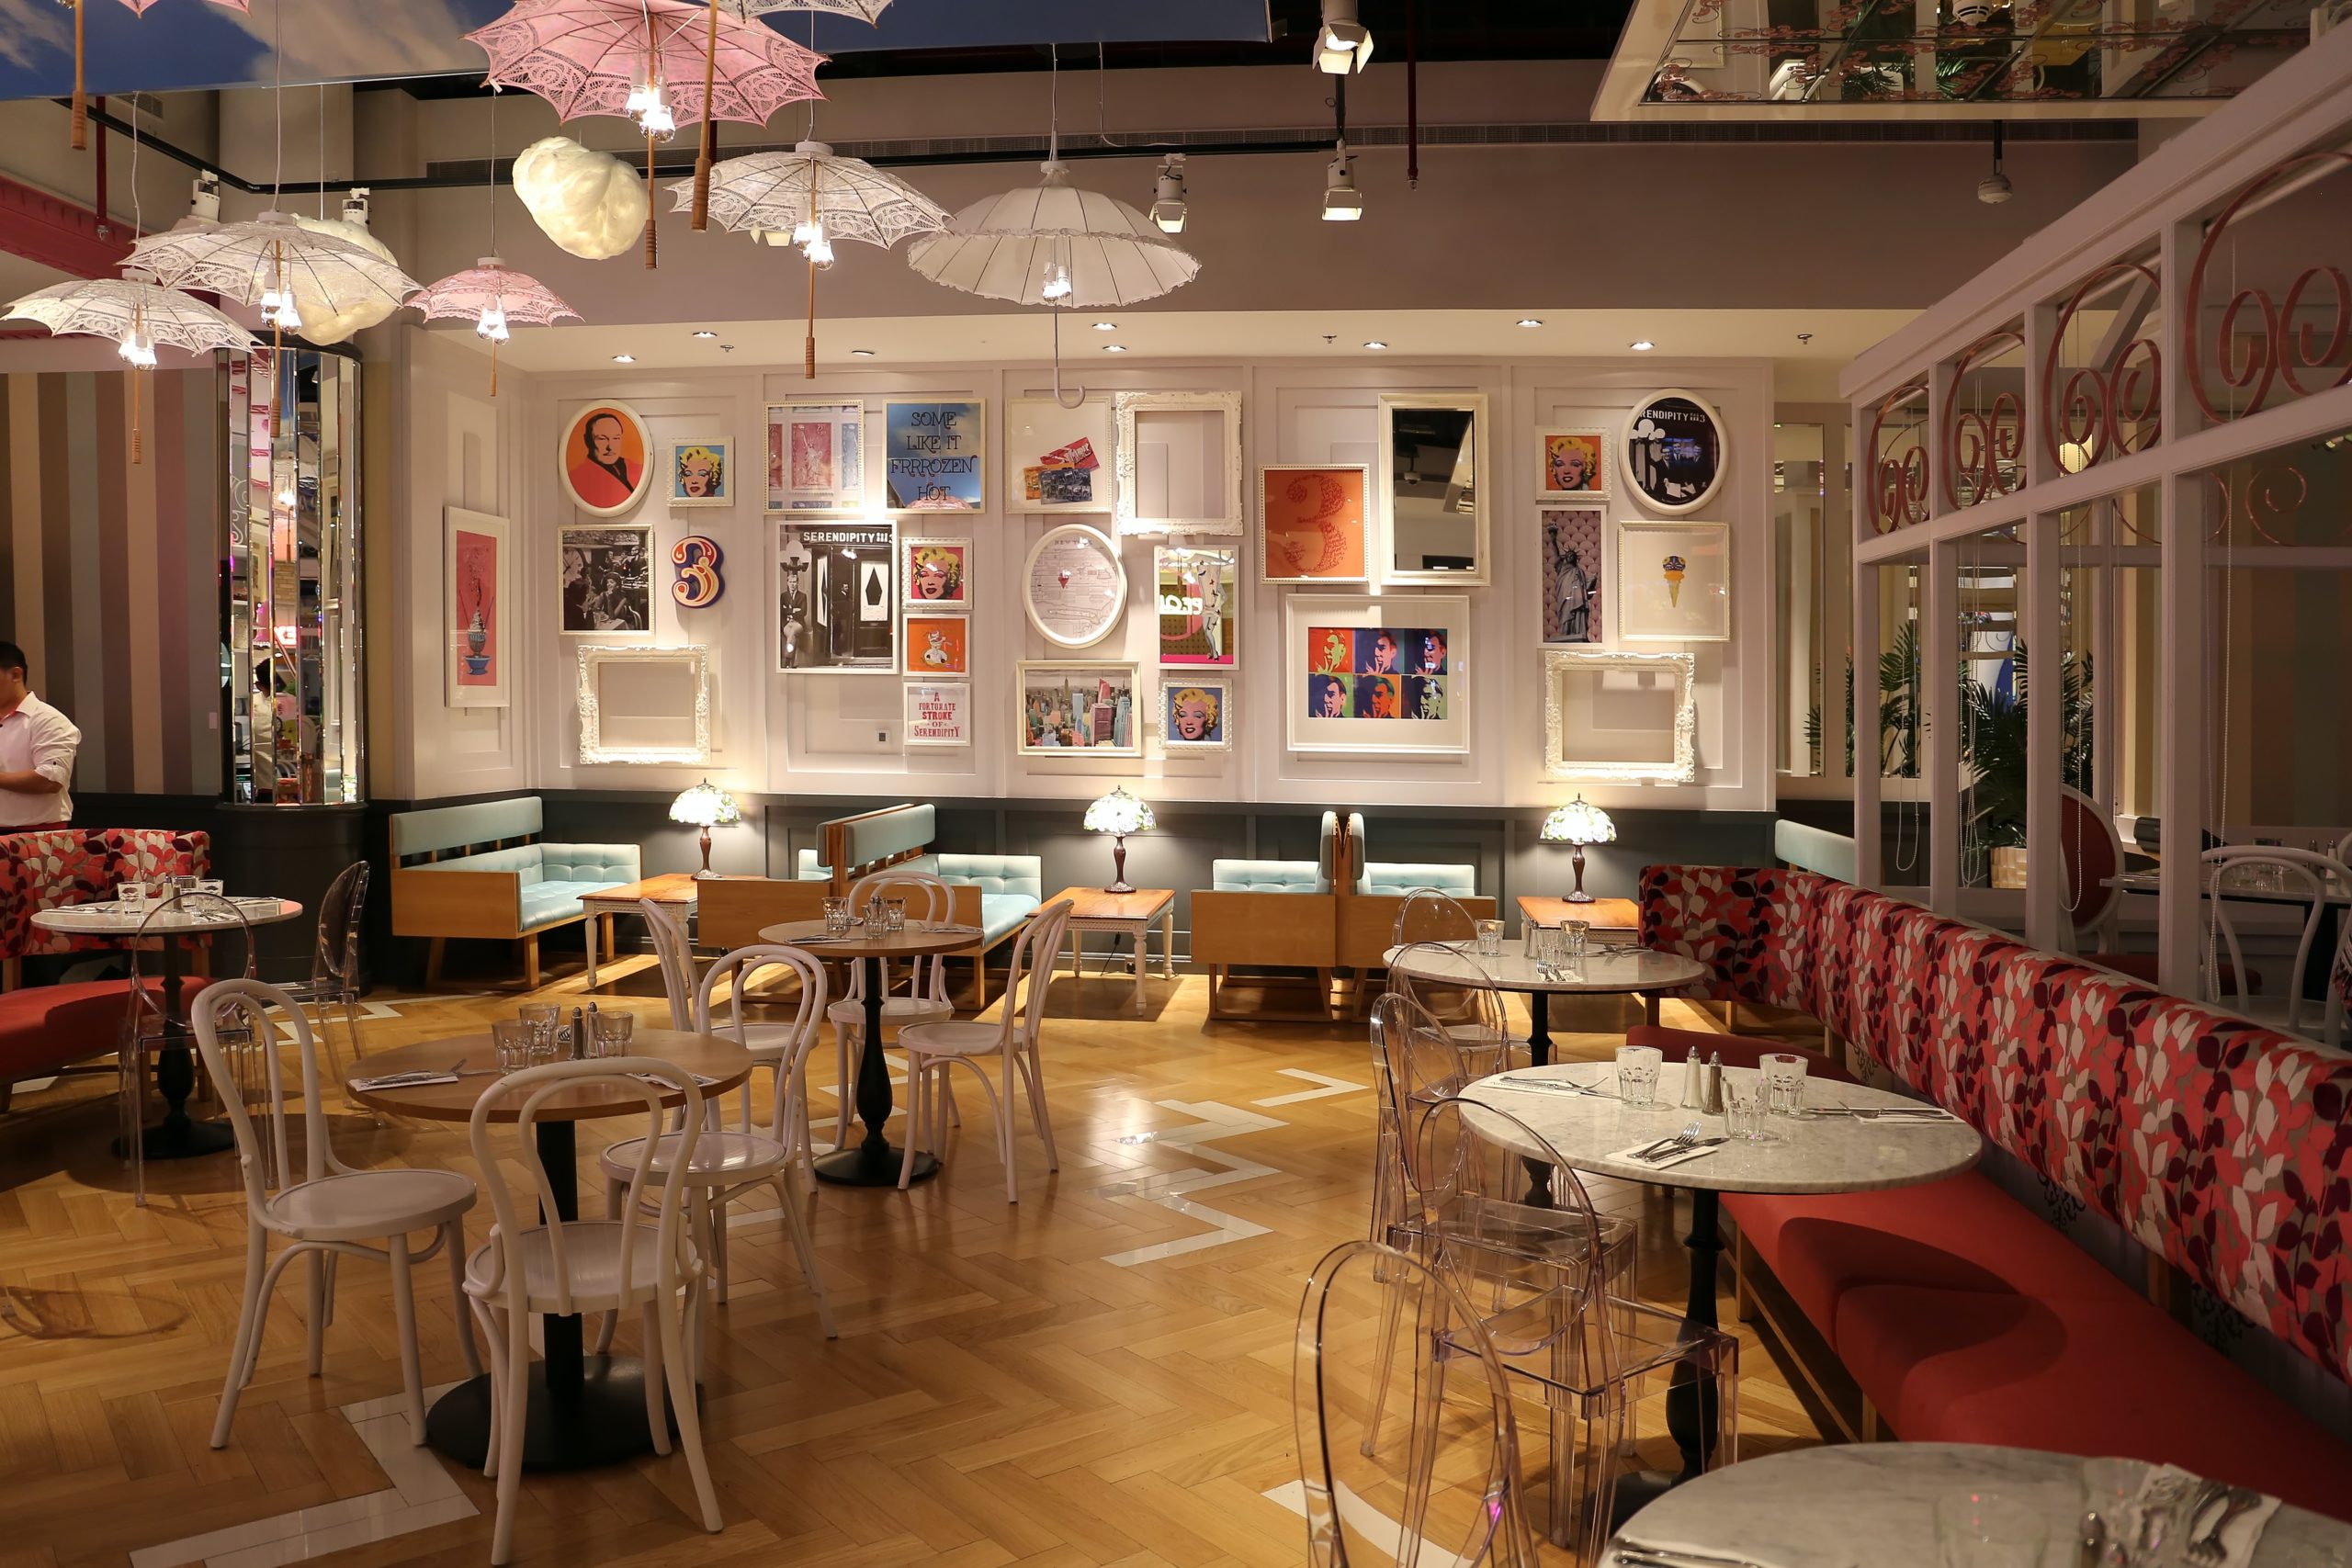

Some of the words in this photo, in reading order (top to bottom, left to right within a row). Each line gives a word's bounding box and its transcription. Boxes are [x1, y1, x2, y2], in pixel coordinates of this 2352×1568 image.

[911, 412, 956, 429] SOME
[906, 435, 941, 453] LIKE
[946, 435, 962, 449] IT
[890, 455, 978, 477] FRRROZEN
[918, 482, 951, 501] HOT
[803, 532, 875, 543] SERENDIPITY
[671, 536, 726, 608] 3
[934, 692, 940, 702] A
[919, 703, 956, 711] FORTUNATE
[922, 712, 953, 720] STROKE
[914, 726, 960, 738] SERENDIPITY
